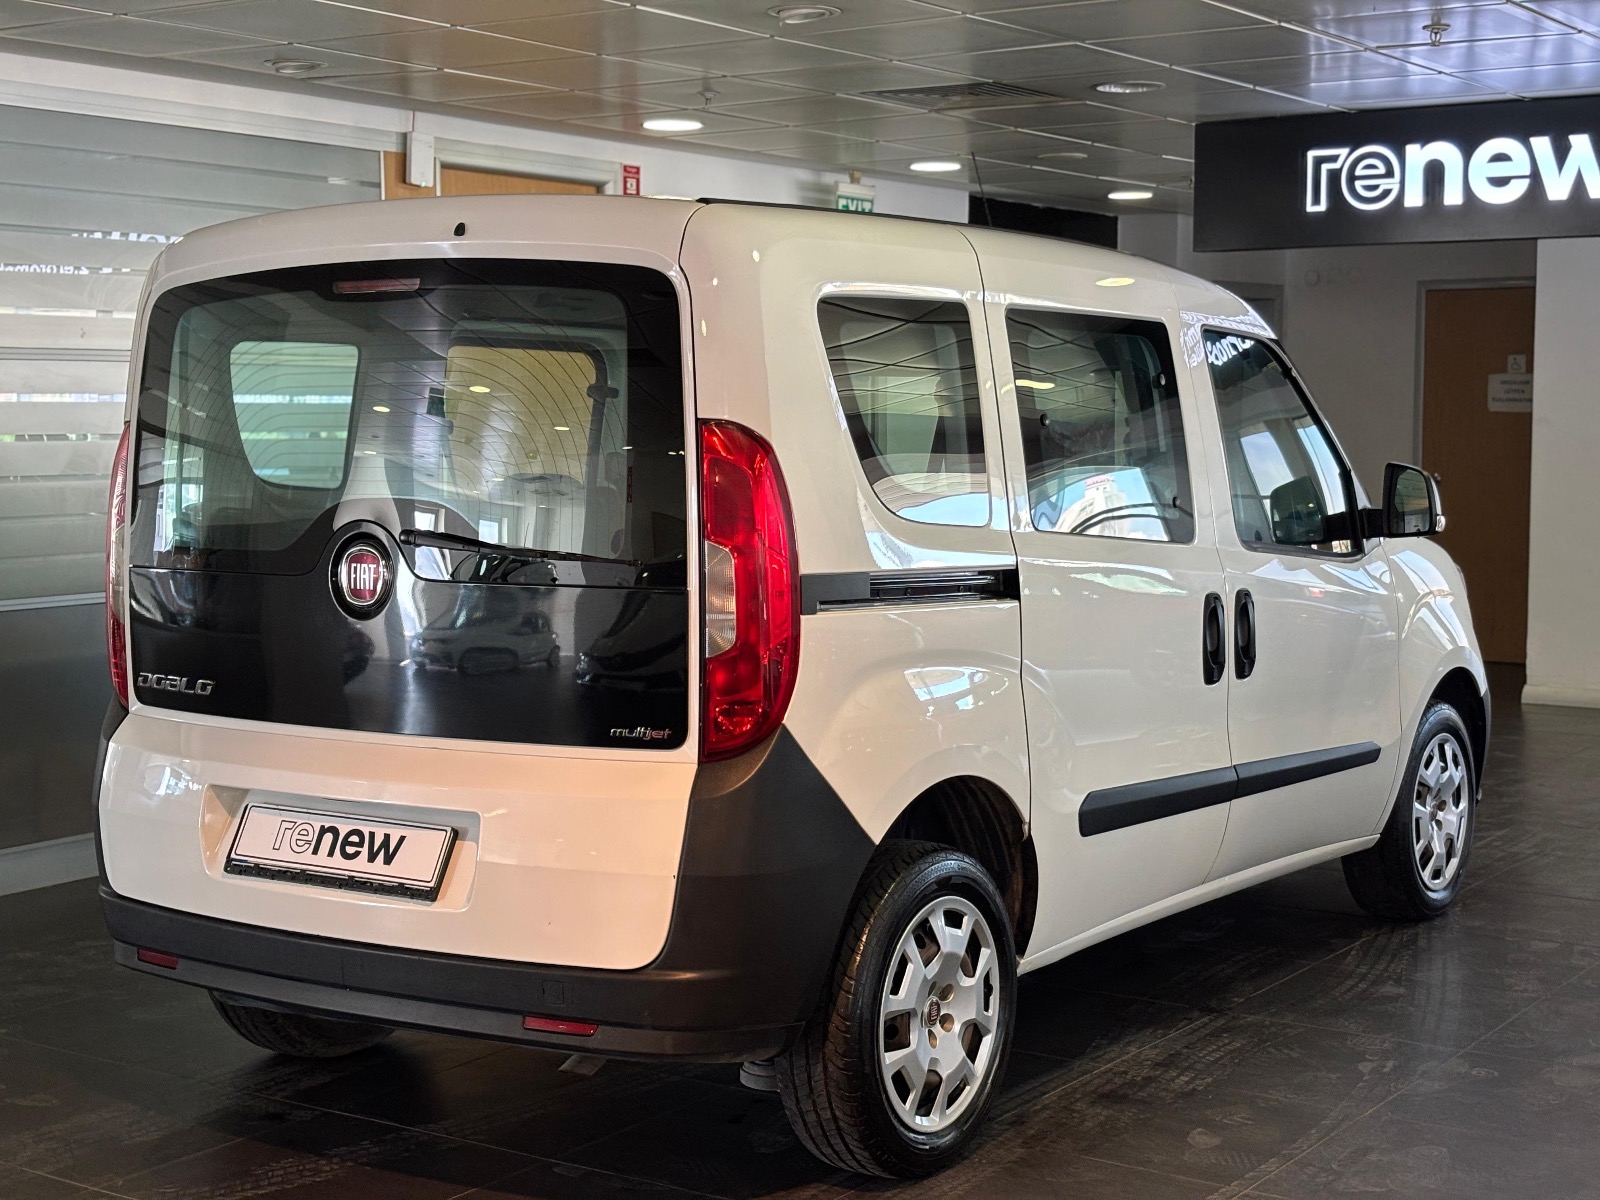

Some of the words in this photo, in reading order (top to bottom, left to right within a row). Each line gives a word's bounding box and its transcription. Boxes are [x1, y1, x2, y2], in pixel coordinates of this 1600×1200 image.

[1306, 134, 1600, 212] renew
[350, 563, 377, 590] FIAT
[609, 726, 673, 741] multijet
[272, 819, 408, 866] renew
